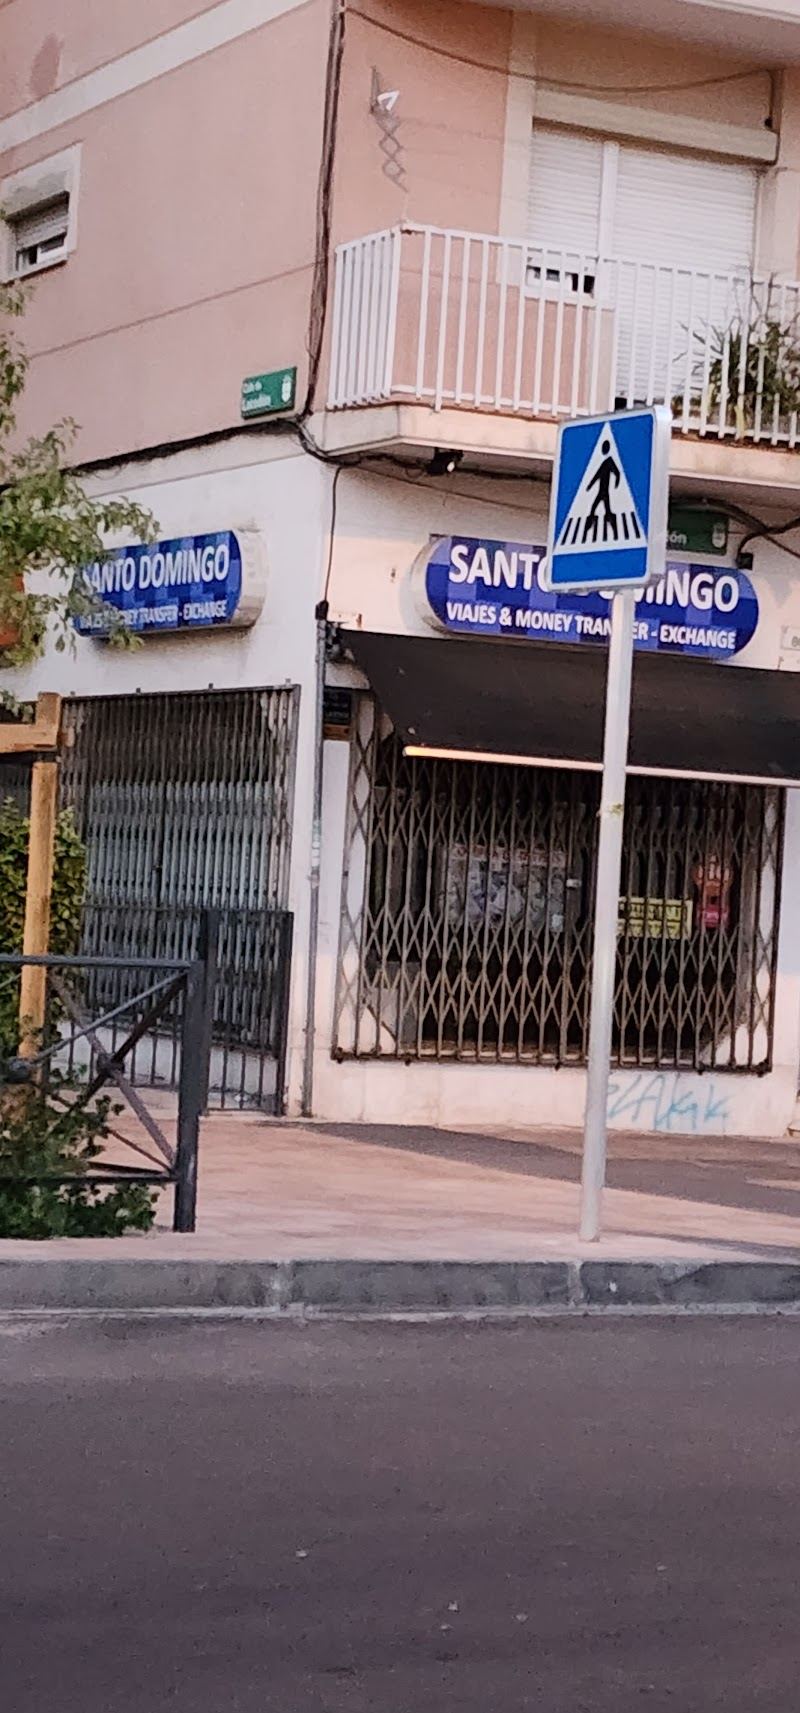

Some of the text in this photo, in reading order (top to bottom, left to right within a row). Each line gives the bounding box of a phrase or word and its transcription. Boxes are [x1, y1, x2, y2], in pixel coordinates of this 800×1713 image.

[138, 543, 230, 590] DOMINGO
[446, 601, 497, 625] VIAJES
[499, 606, 513, 627] &
[515, 608, 573, 633] MONEY
[574, 614, 649, 640] TRANER
[660, 623, 737, 650] EXCHANGE
